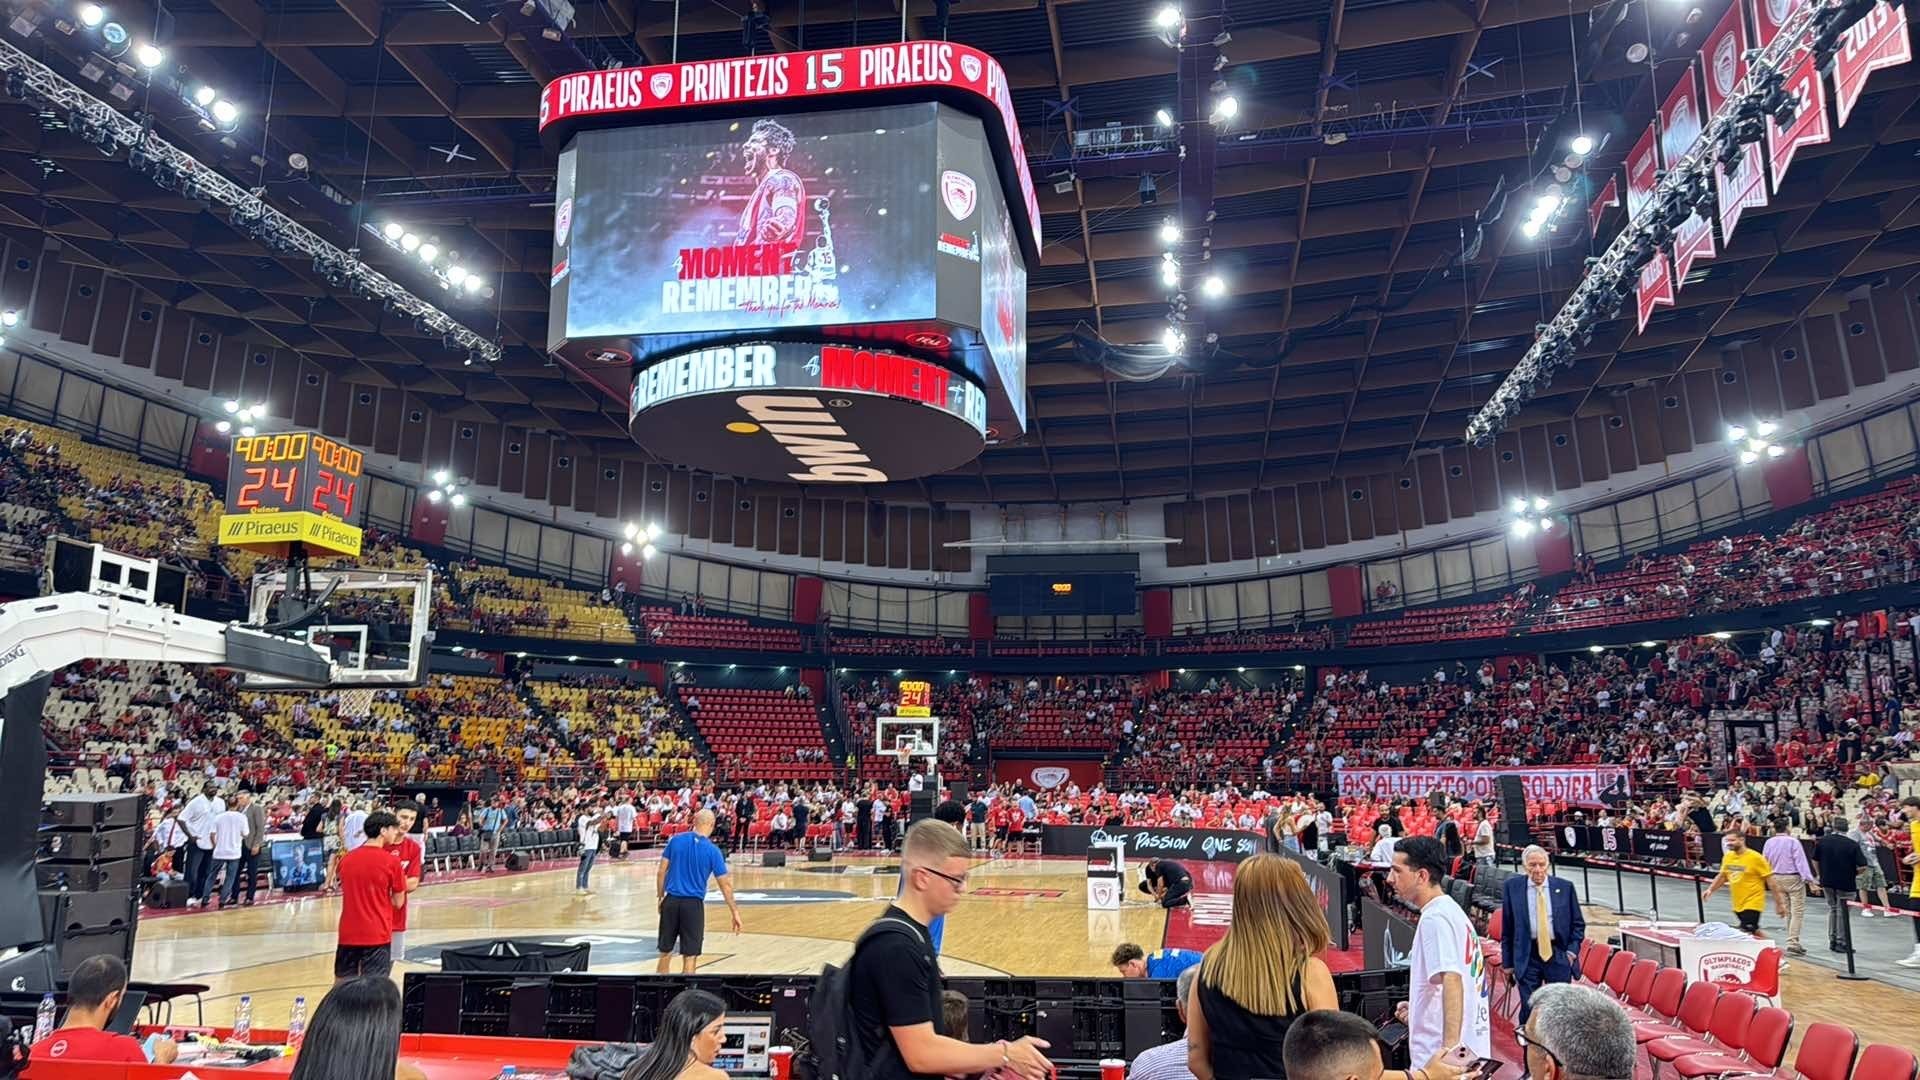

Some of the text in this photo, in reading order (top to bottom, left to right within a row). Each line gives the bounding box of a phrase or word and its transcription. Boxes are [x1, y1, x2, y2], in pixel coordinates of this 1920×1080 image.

[558, 70, 643, 115] PIRAEUS
[680, 56, 789, 103] PRINTEZIS
[806, 53, 843, 91] 15
[859, 43, 953, 87] PIRAEUS
[679, 242, 798, 280] MOMENT
[638, 345, 777, 411] REMEMBER
[802, 355, 820, 377] A
[821, 346, 950, 409] MOMENT
[236, 434, 308, 462] 90:00
[312, 436, 363, 477] 90:00
[237, 467, 297, 507] 24
[313, 470, 356, 517] 24
[245, 521, 298, 535] Piraeus
[322, 525, 358, 547] Piraeus
[901, 691, 922, 705] 24
[1134, 831, 1194, 850] PASSION
[1202, 836, 1232, 852] ONE
[1602, 828, 1617, 850] 15
